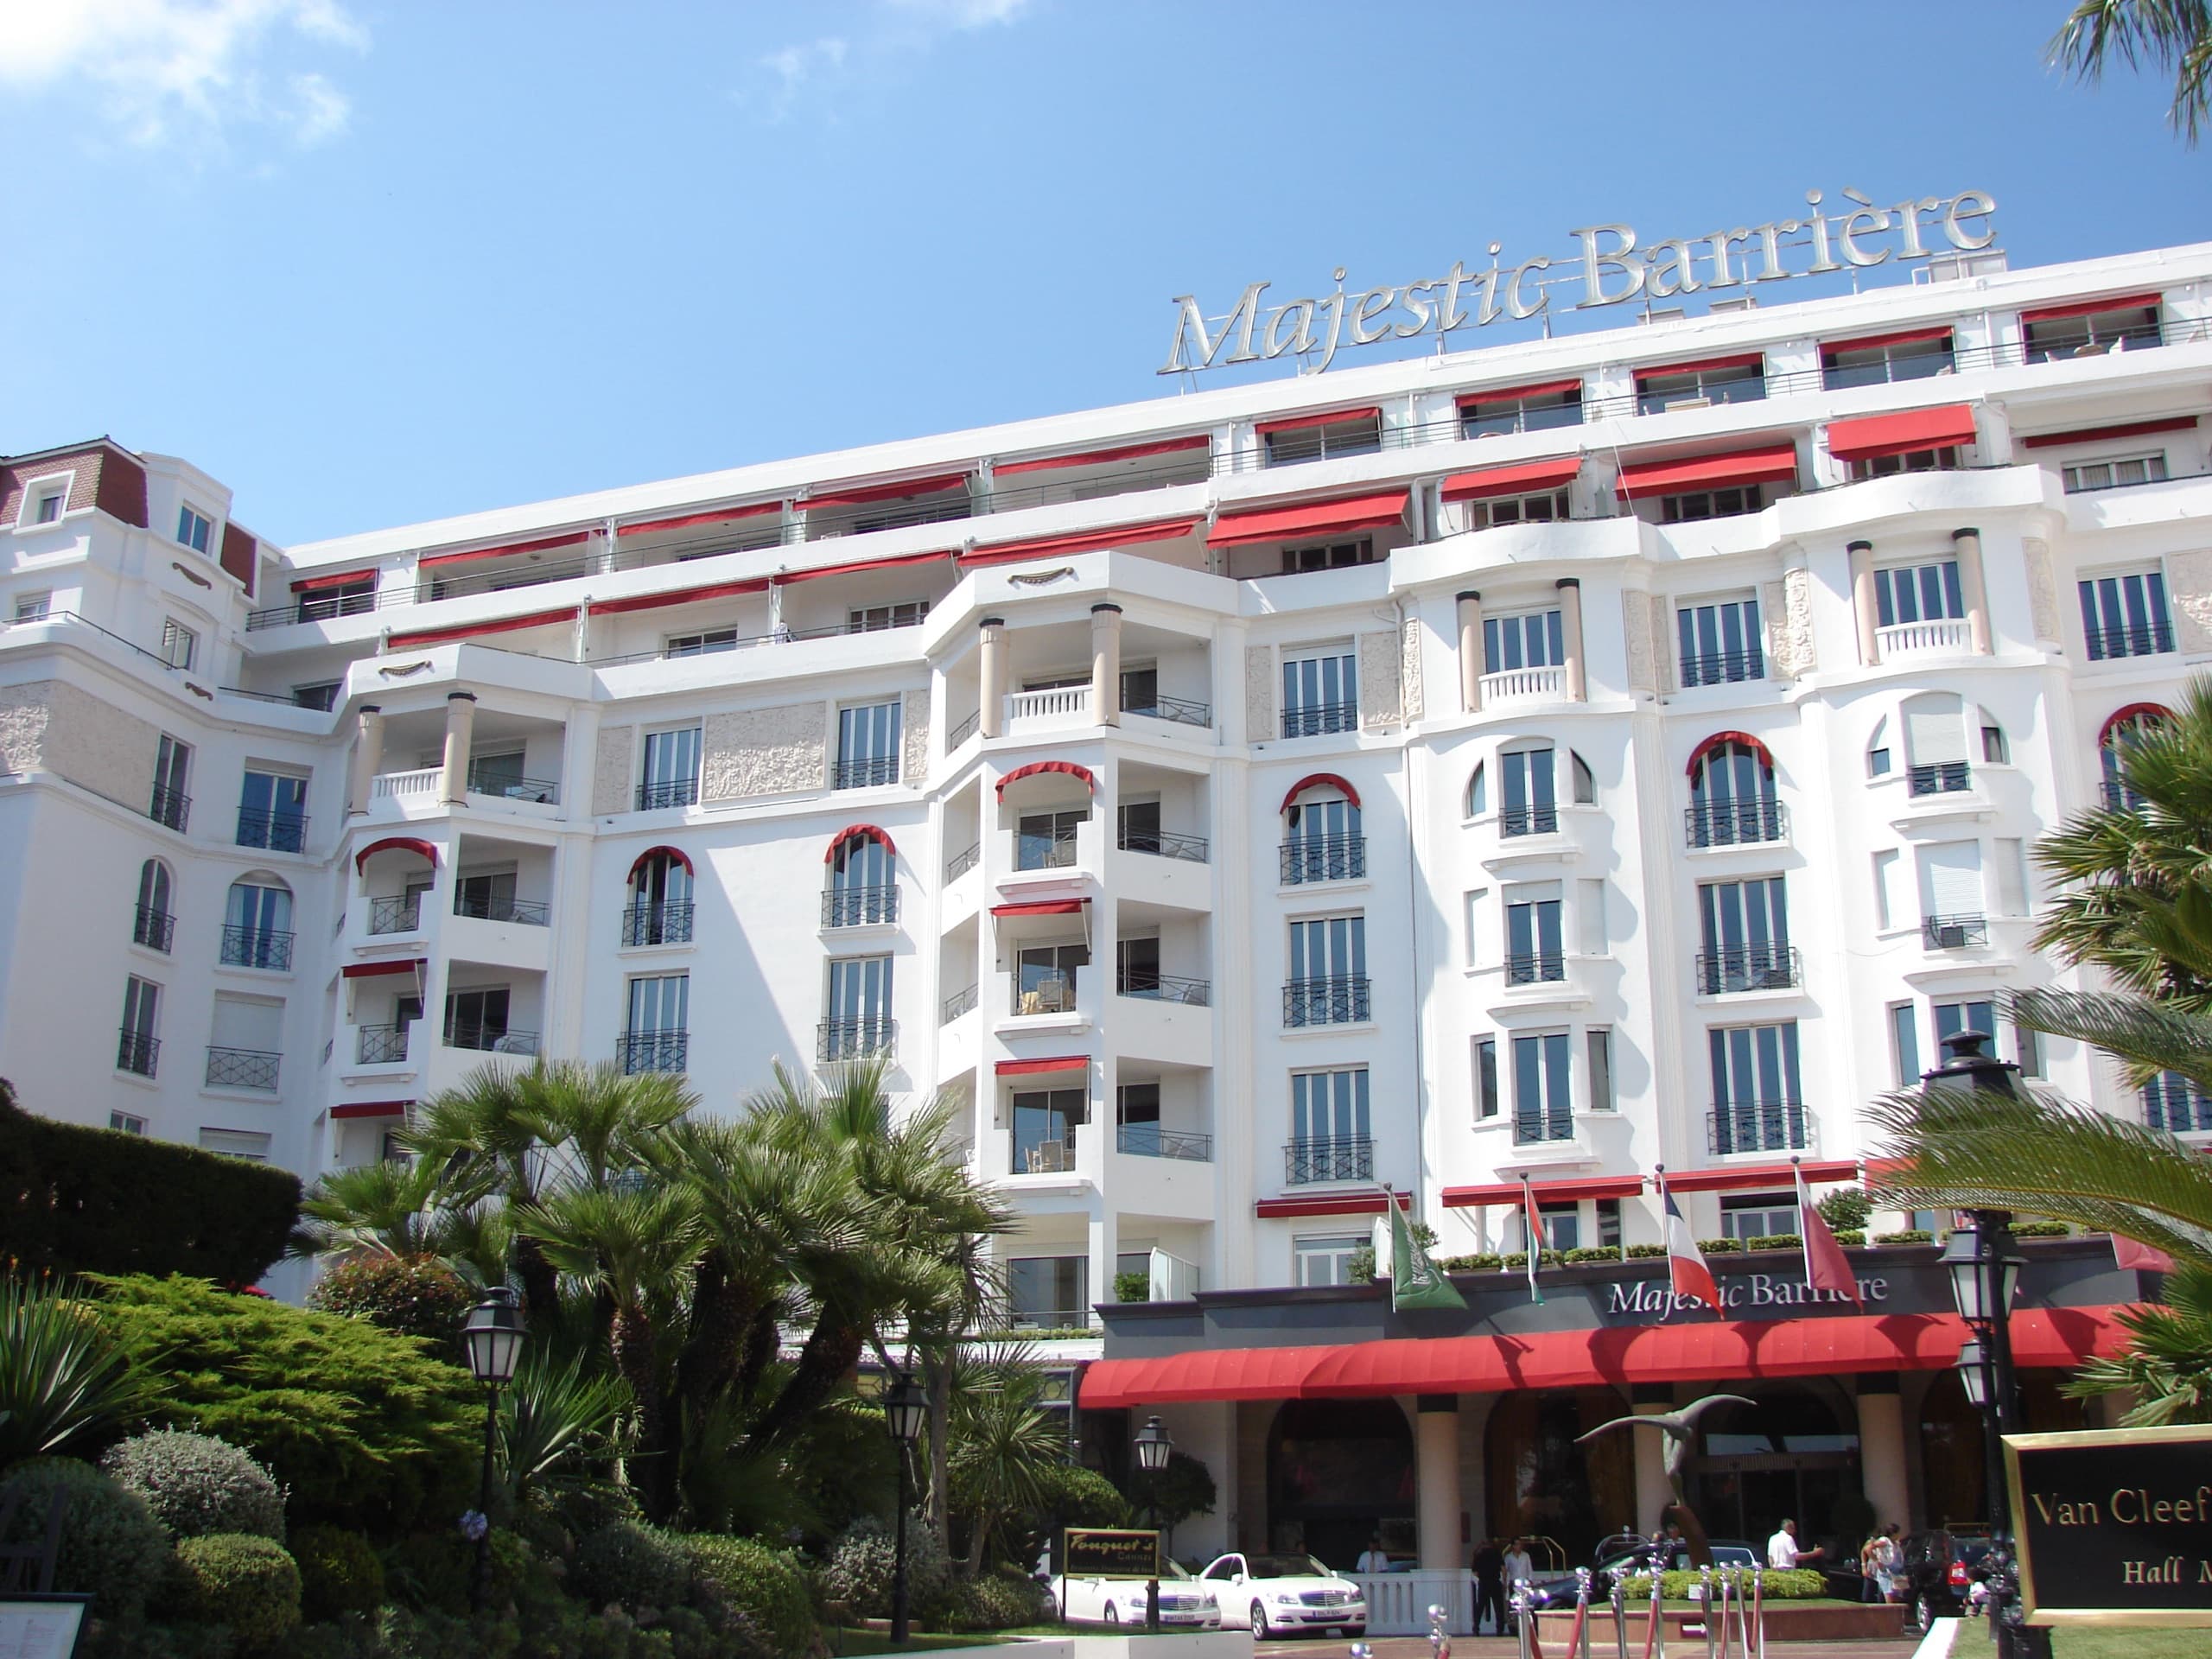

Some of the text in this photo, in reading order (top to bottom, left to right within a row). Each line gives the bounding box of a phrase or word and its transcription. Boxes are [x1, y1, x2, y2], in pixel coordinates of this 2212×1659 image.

[1156, 187, 1997, 375] Majestic Barrière
[1607, 1275, 1744, 1321] Majesic
[2031, 1485, 2212, 1526] Van Cleef
[2122, 1555, 2184, 1584] Hall
